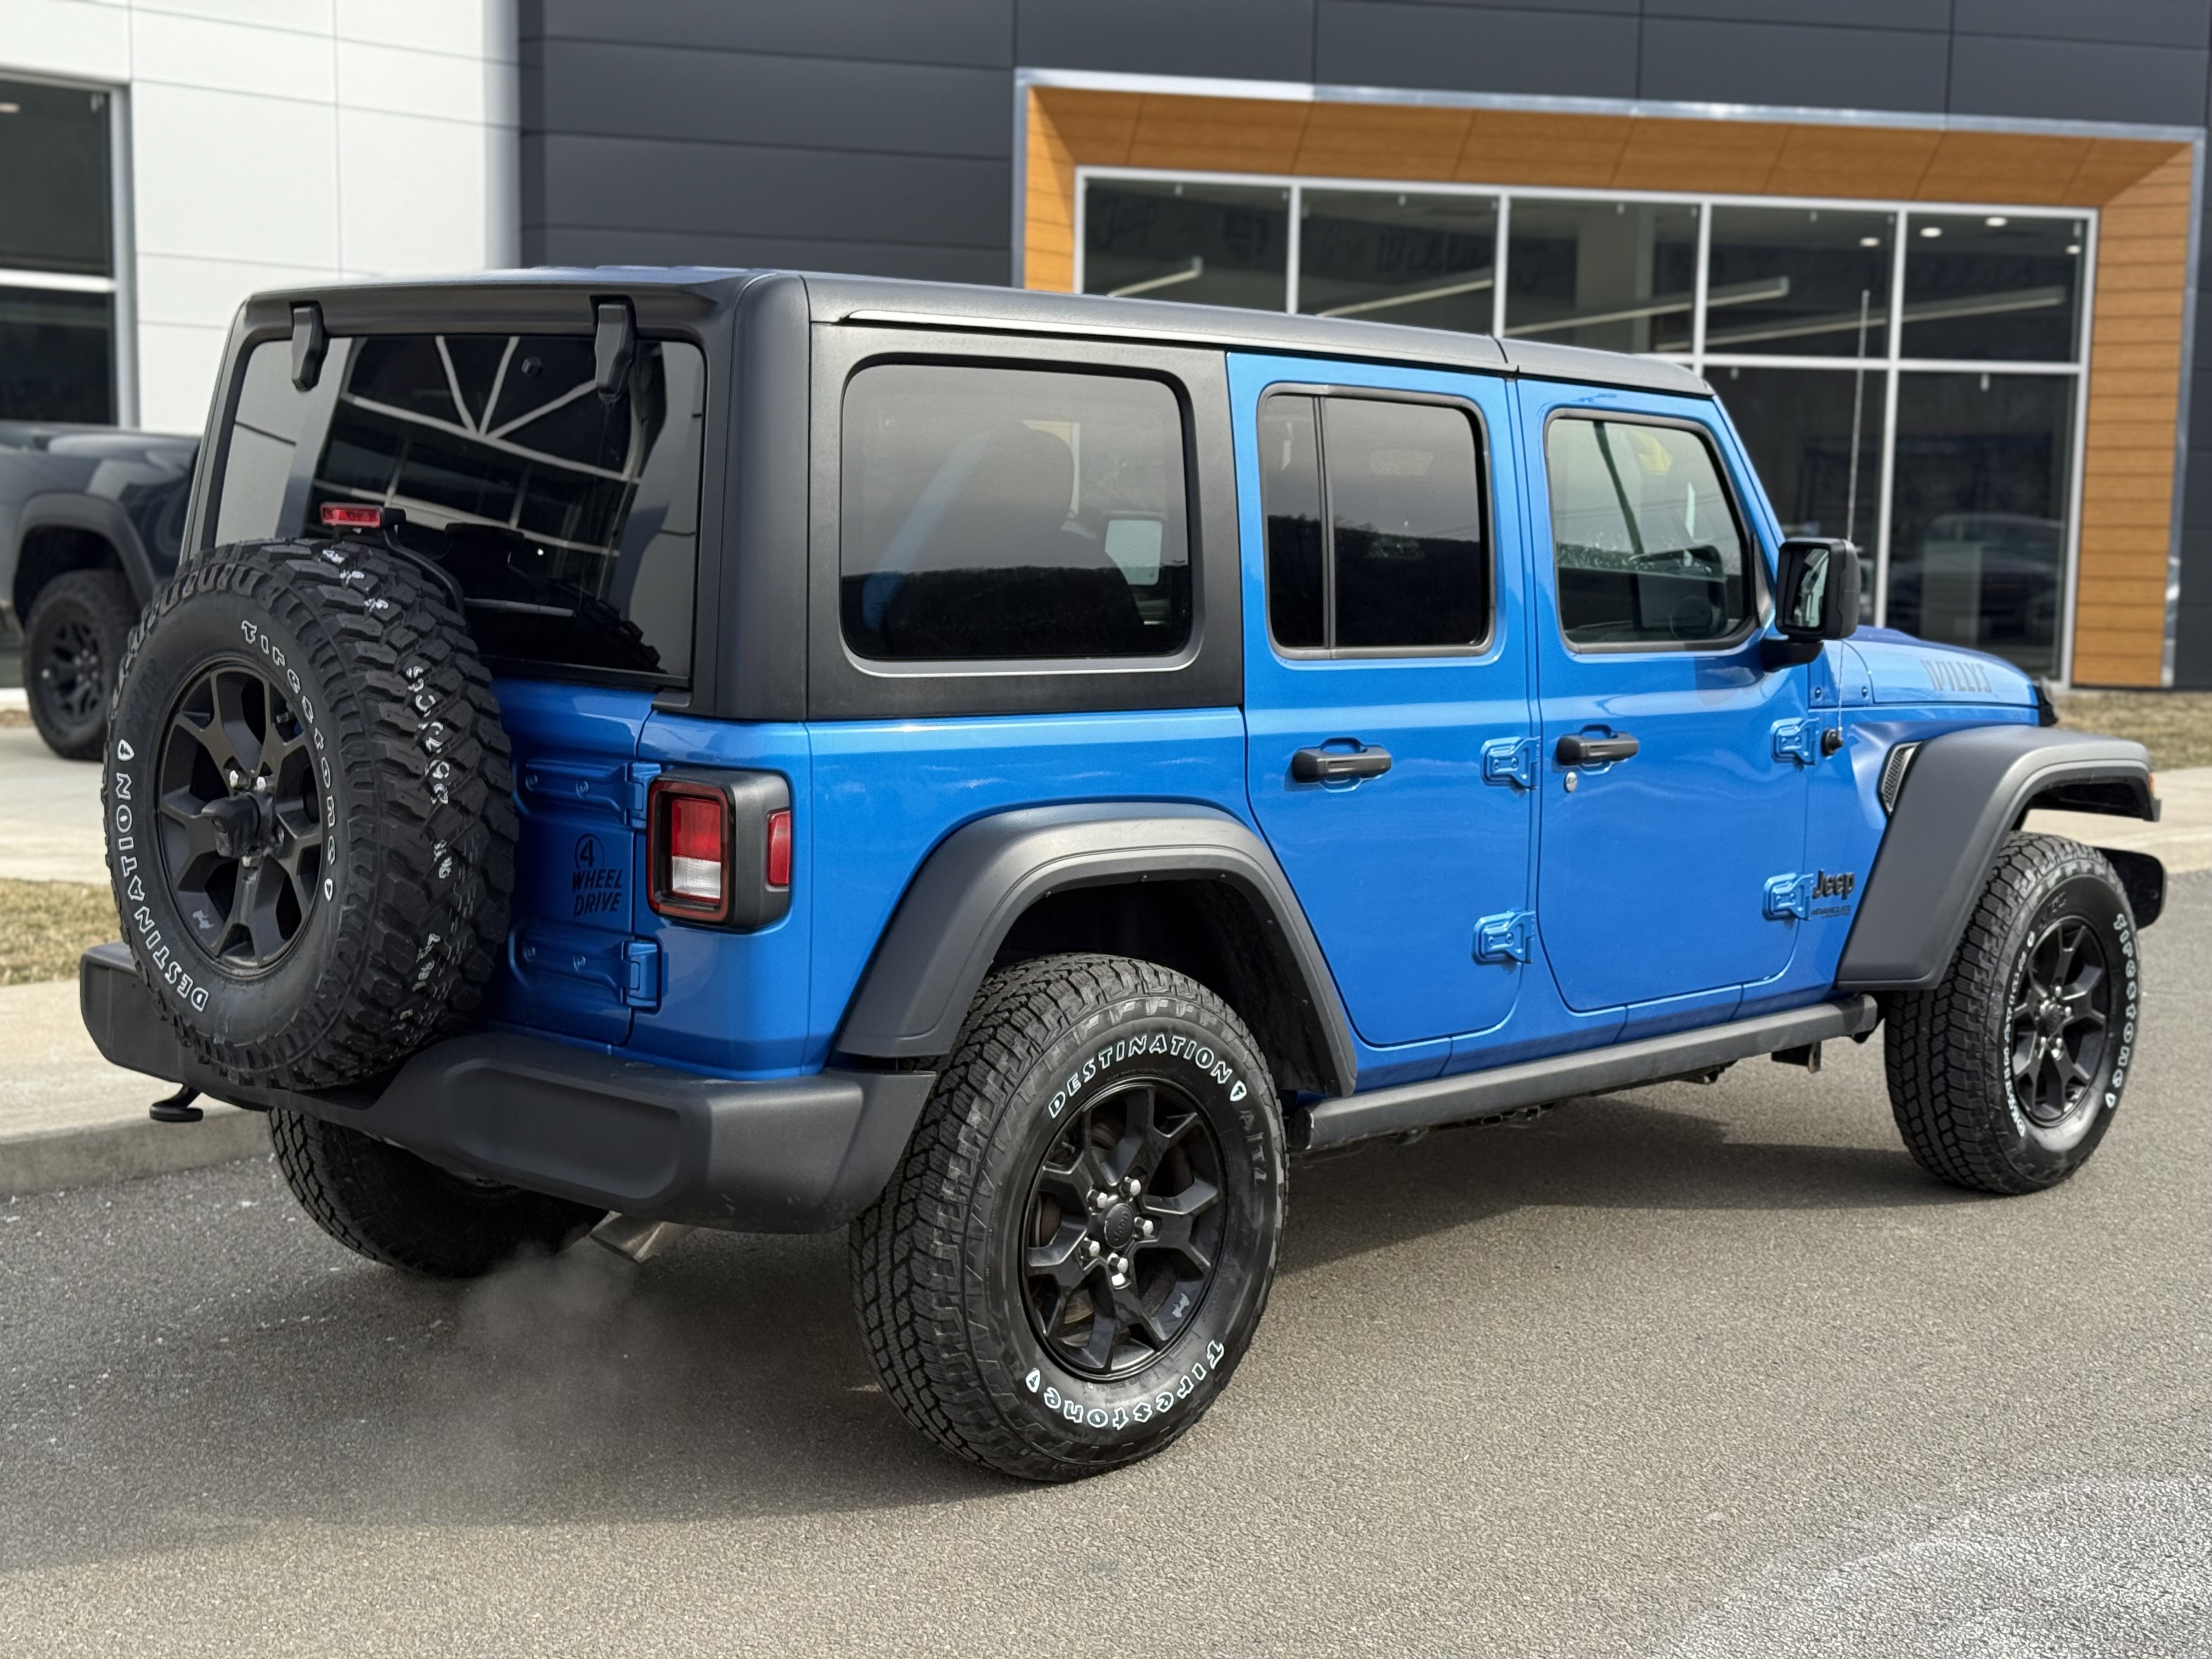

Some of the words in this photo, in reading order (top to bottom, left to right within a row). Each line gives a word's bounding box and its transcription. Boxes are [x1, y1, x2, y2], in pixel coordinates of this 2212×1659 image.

[1920, 660, 1993, 692] WILLYS
[241, 620, 336, 865] Firestone
[572, 868, 623, 894] WHEEL
[579, 839, 595, 868] 4
[115, 772, 210, 1013] DESTINATION
[573, 891, 622, 918] DRIVE
[1812, 869, 1854, 900] Jeep
[2112, 913, 2137, 1088] Firestone
[1047, 1032, 1233, 1120] DESTINATION
[1043, 1339, 1224, 1430] Firestone
